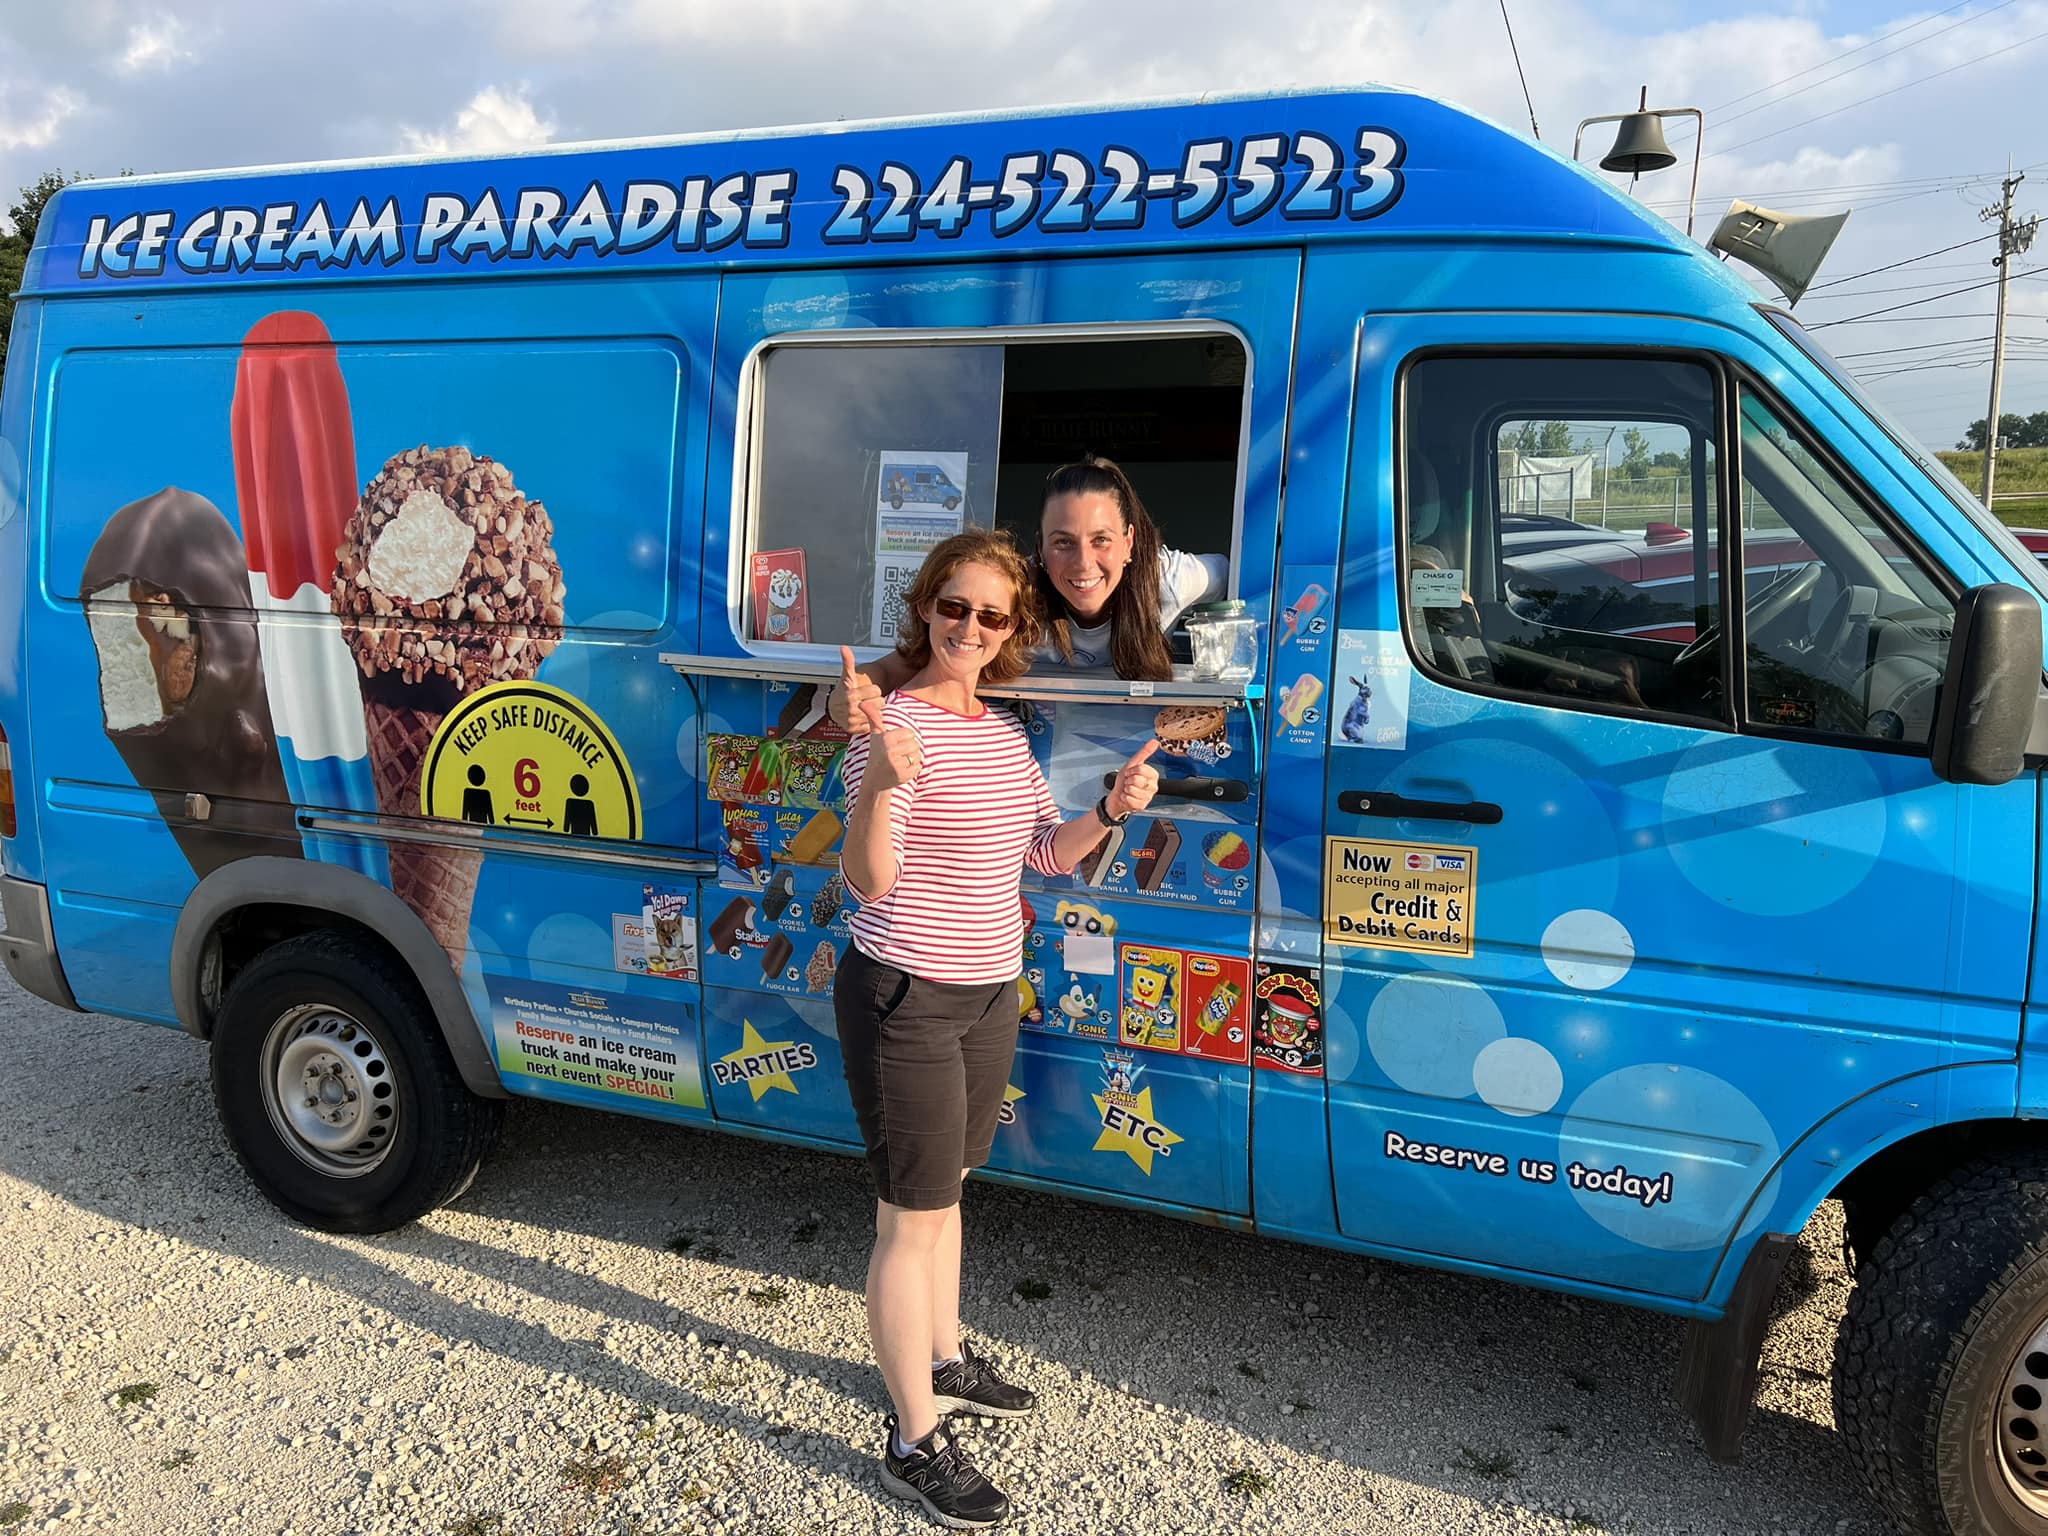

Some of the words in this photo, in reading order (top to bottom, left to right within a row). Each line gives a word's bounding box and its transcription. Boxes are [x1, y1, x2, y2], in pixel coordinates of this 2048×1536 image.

[79, 209, 174, 278] ICE
[175, 196, 404, 275] CREAM
[414, 169, 797, 264] PARADISE
[822, 126, 1406, 244] 224-522-5523
[453, 716, 487, 756] KEEP
[491, 705, 528, 731] SAFE
[533, 706, 604, 769] DISTANCE
[1288, 729, 1315, 737] COTTON
[514, 758, 541, 799] 6
[515, 799, 542, 812] feet
[723, 808, 759, 827] LUCHAS
[1343, 848, 1391, 873] Now
[1440, 860, 1462, 869] VISA
[1100, 886, 1129, 894] VANILLA
[1136, 888, 1178, 900] MISSISSIPPI
[1213, 888, 1242, 897] BUBBLE
[1336, 874, 1400, 891] accepting
[1404, 878, 1420, 889] all
[1424, 882, 1465, 895] major
[1218, 898, 1237, 906] GUM
[1371, 892, 1438, 920] Credit
[1446, 899, 1462, 922] &
[1338, 915, 1397, 938] Debit
[1404, 922, 1461, 944] Cards
[504, 996, 532, 1010] Birthday
[533, 1001, 558, 1012] Parties
[563, 1007, 589, 1018] Church
[589, 1011, 614, 1022] Socials
[621, 1017, 653, 1031] Company
[655, 1022, 680, 1034] Picnics
[516, 1021, 575, 1044] Reserve
[579, 1035, 597, 1049] an
[602, 1036, 625, 1054] ice
[629, 1044, 677, 1065] cream
[597, 1023, 621, 1034] Parties
[628, 1029, 646, 1038] Fund
[1076, 1024, 1108, 1035] SONIC
[521, 1039, 560, 1060] truck
[563, 1049, 591, 1066] and
[595, 1056, 636, 1079] make
[640, 1065, 675, 1083] your
[712, 1044, 817, 1085] PARTIES
[526, 1061, 558, 1078] next
[562, 1069, 603, 1086] event
[607, 1074, 675, 1100] SPECIAL!
[1103, 1090, 1138, 1103] SONIC
[1104, 1104, 1172, 1156] ETC.
[1386, 1131, 1507, 1174] Reserve
[1520, 1160, 1555, 1182] us
[1569, 1163, 1672, 1206] today!
